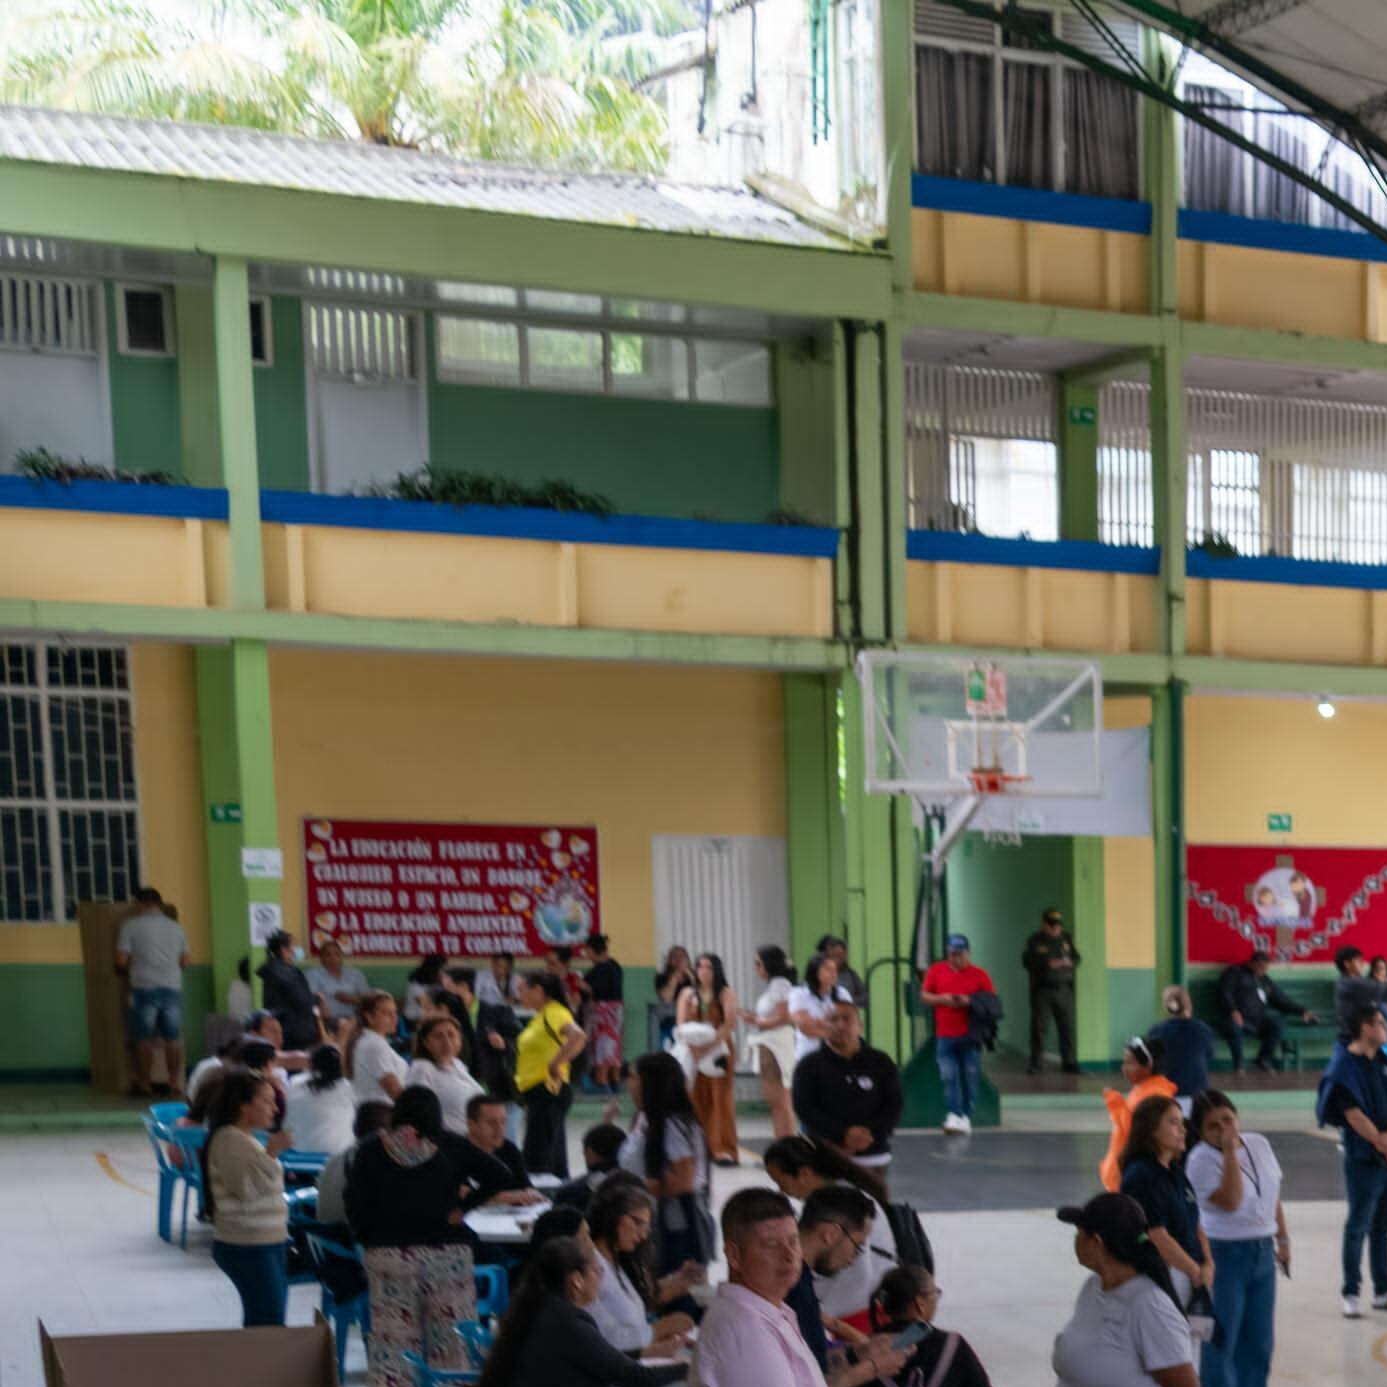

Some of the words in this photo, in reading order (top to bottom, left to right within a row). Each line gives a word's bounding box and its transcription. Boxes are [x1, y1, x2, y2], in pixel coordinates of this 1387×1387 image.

[329, 838, 349, 858] LA
[351, 836, 432, 861] EDUCACIÓN
[438, 840, 501, 861] FLORECE
[506, 842, 527, 861] EN
[313, 863, 393, 884] CUALQUIER
[460, 867, 481, 885] UN
[317, 887, 338, 907] UN
[343, 887, 394, 908] MUSEO
[398, 888, 410, 909] O
[415, 890, 436, 910] UN
[338, 910, 360, 931] LA
[363, 908, 441, 932] EDUCACIÓN
[447, 913, 527, 933] AMBIENTAL
[352, 933, 413, 953] FLORECE
[415, 934, 436, 953] EN
